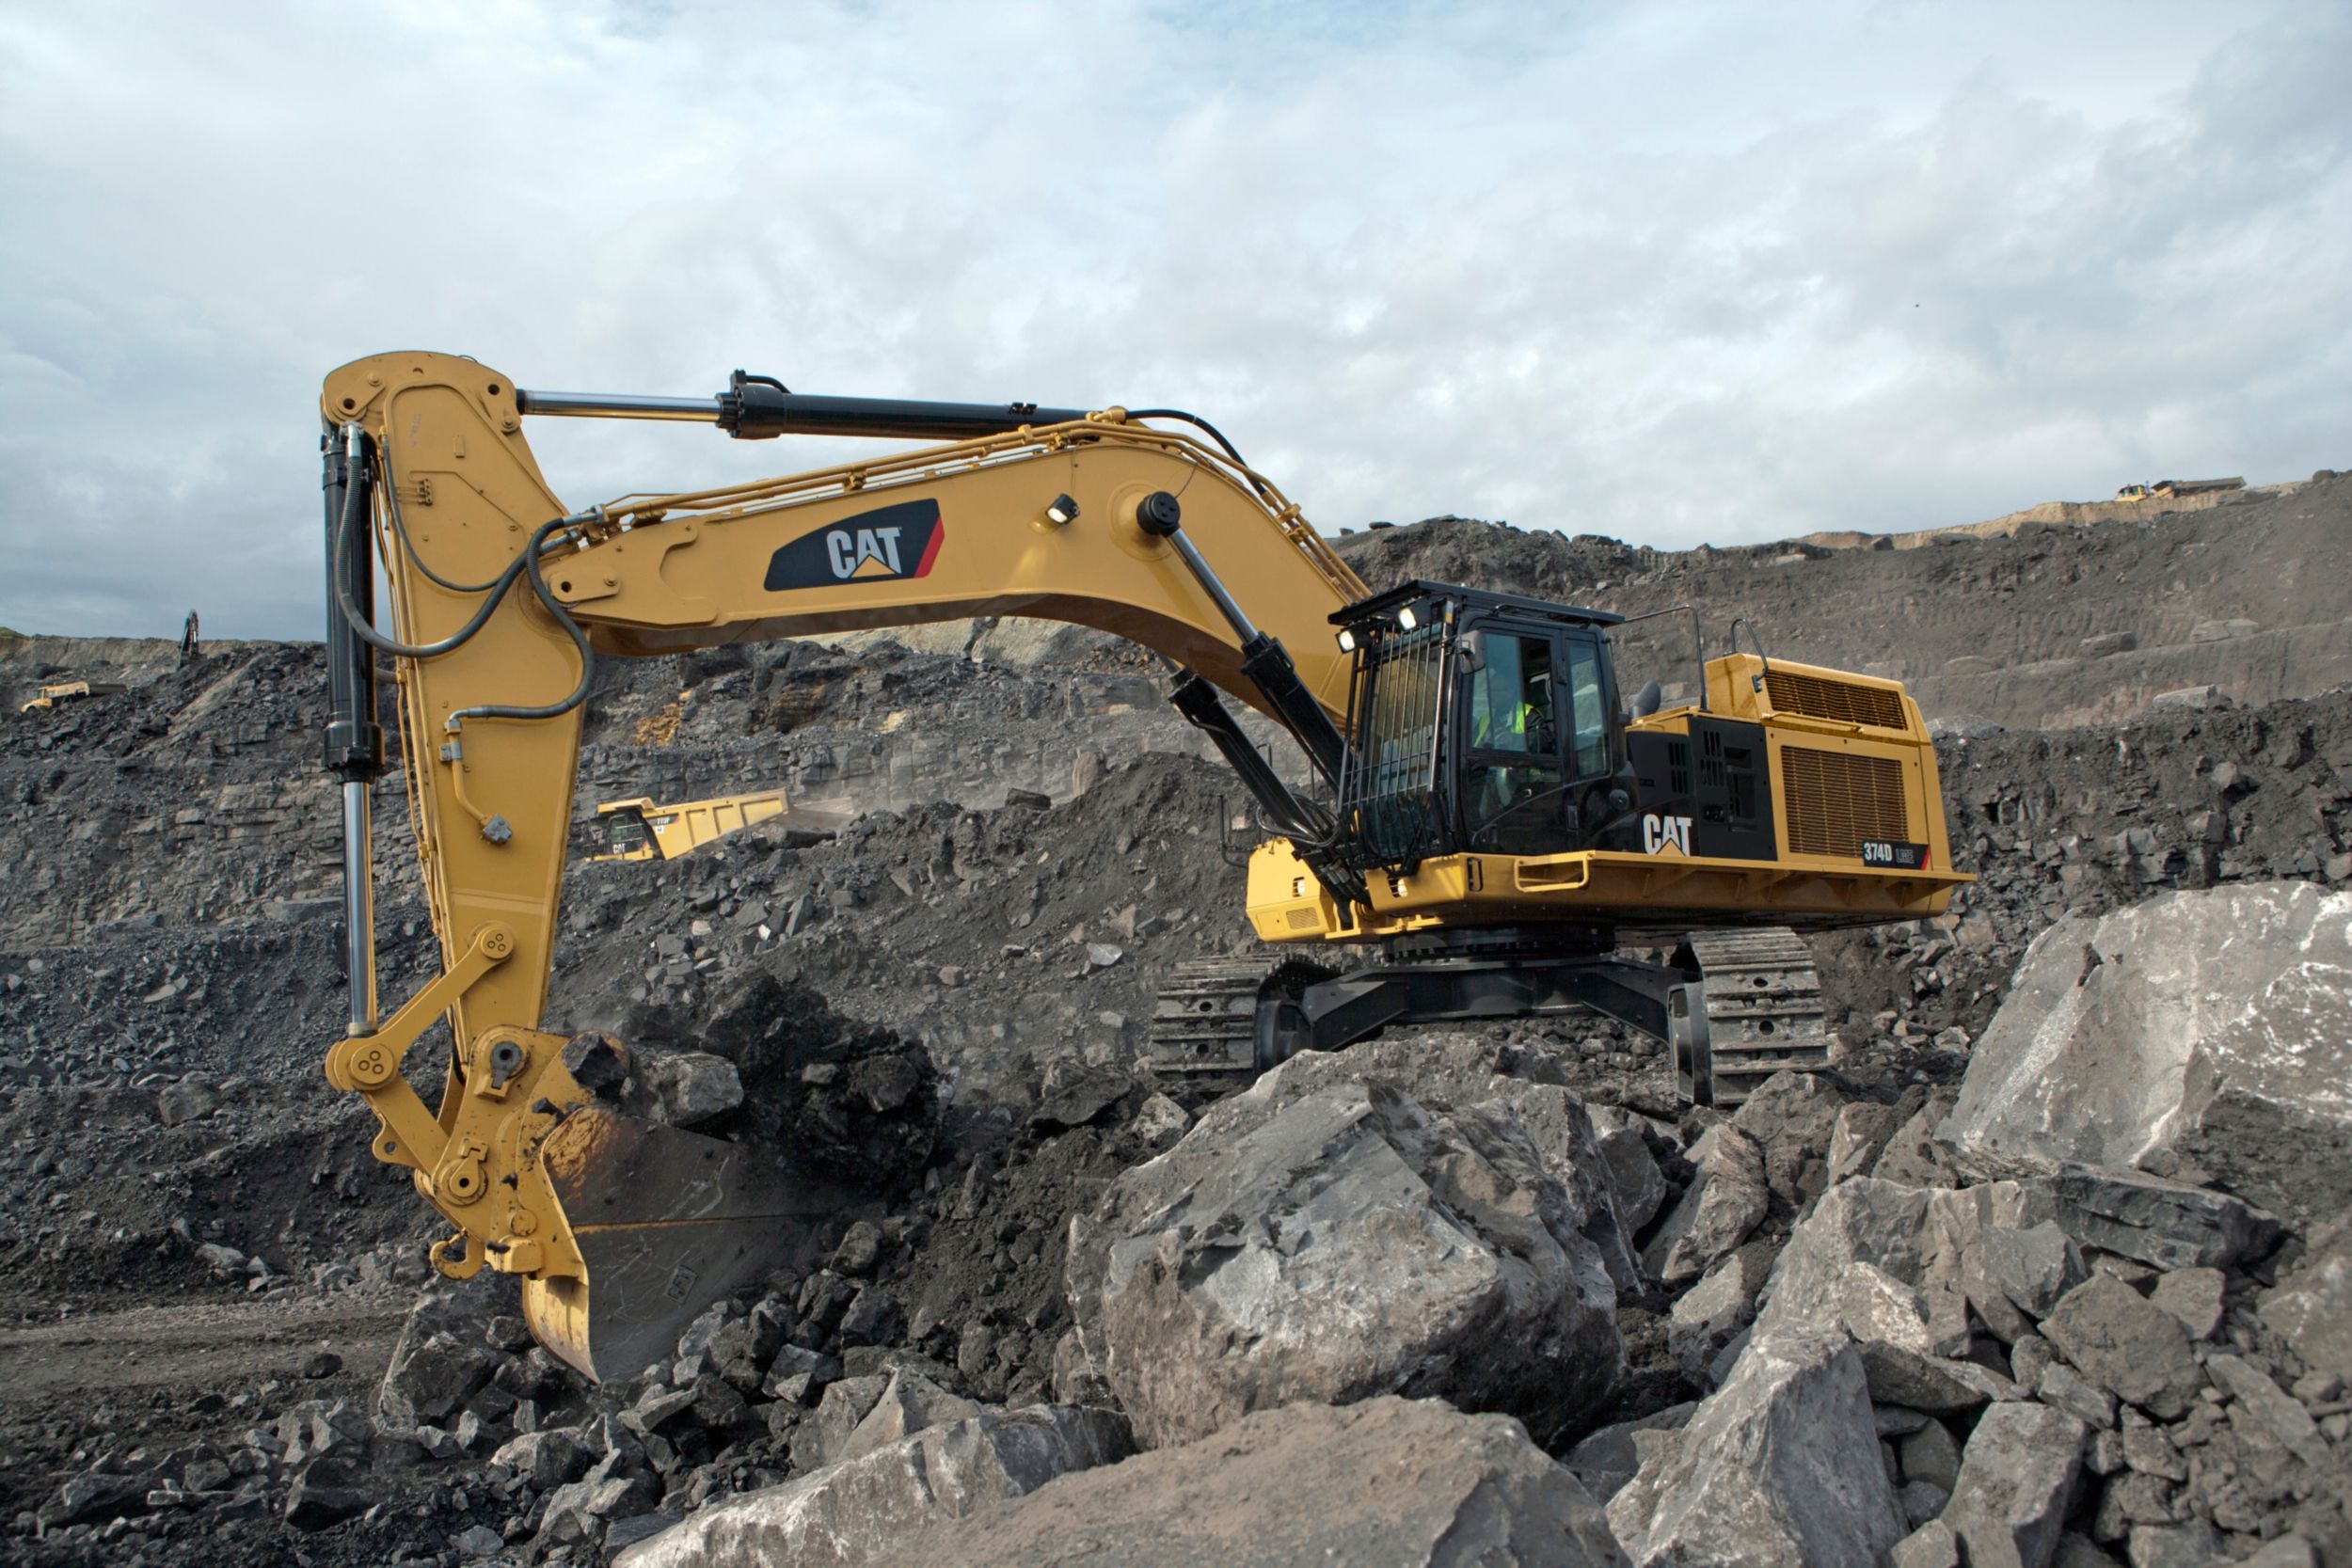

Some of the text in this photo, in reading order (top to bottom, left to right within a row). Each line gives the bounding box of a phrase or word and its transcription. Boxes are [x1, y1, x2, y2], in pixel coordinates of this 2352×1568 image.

[826, 527, 902, 578] CAT
[612, 843, 626, 854] CAT
[1643, 814, 1692, 857] CAT
[1864, 842, 1892, 862] 374D
